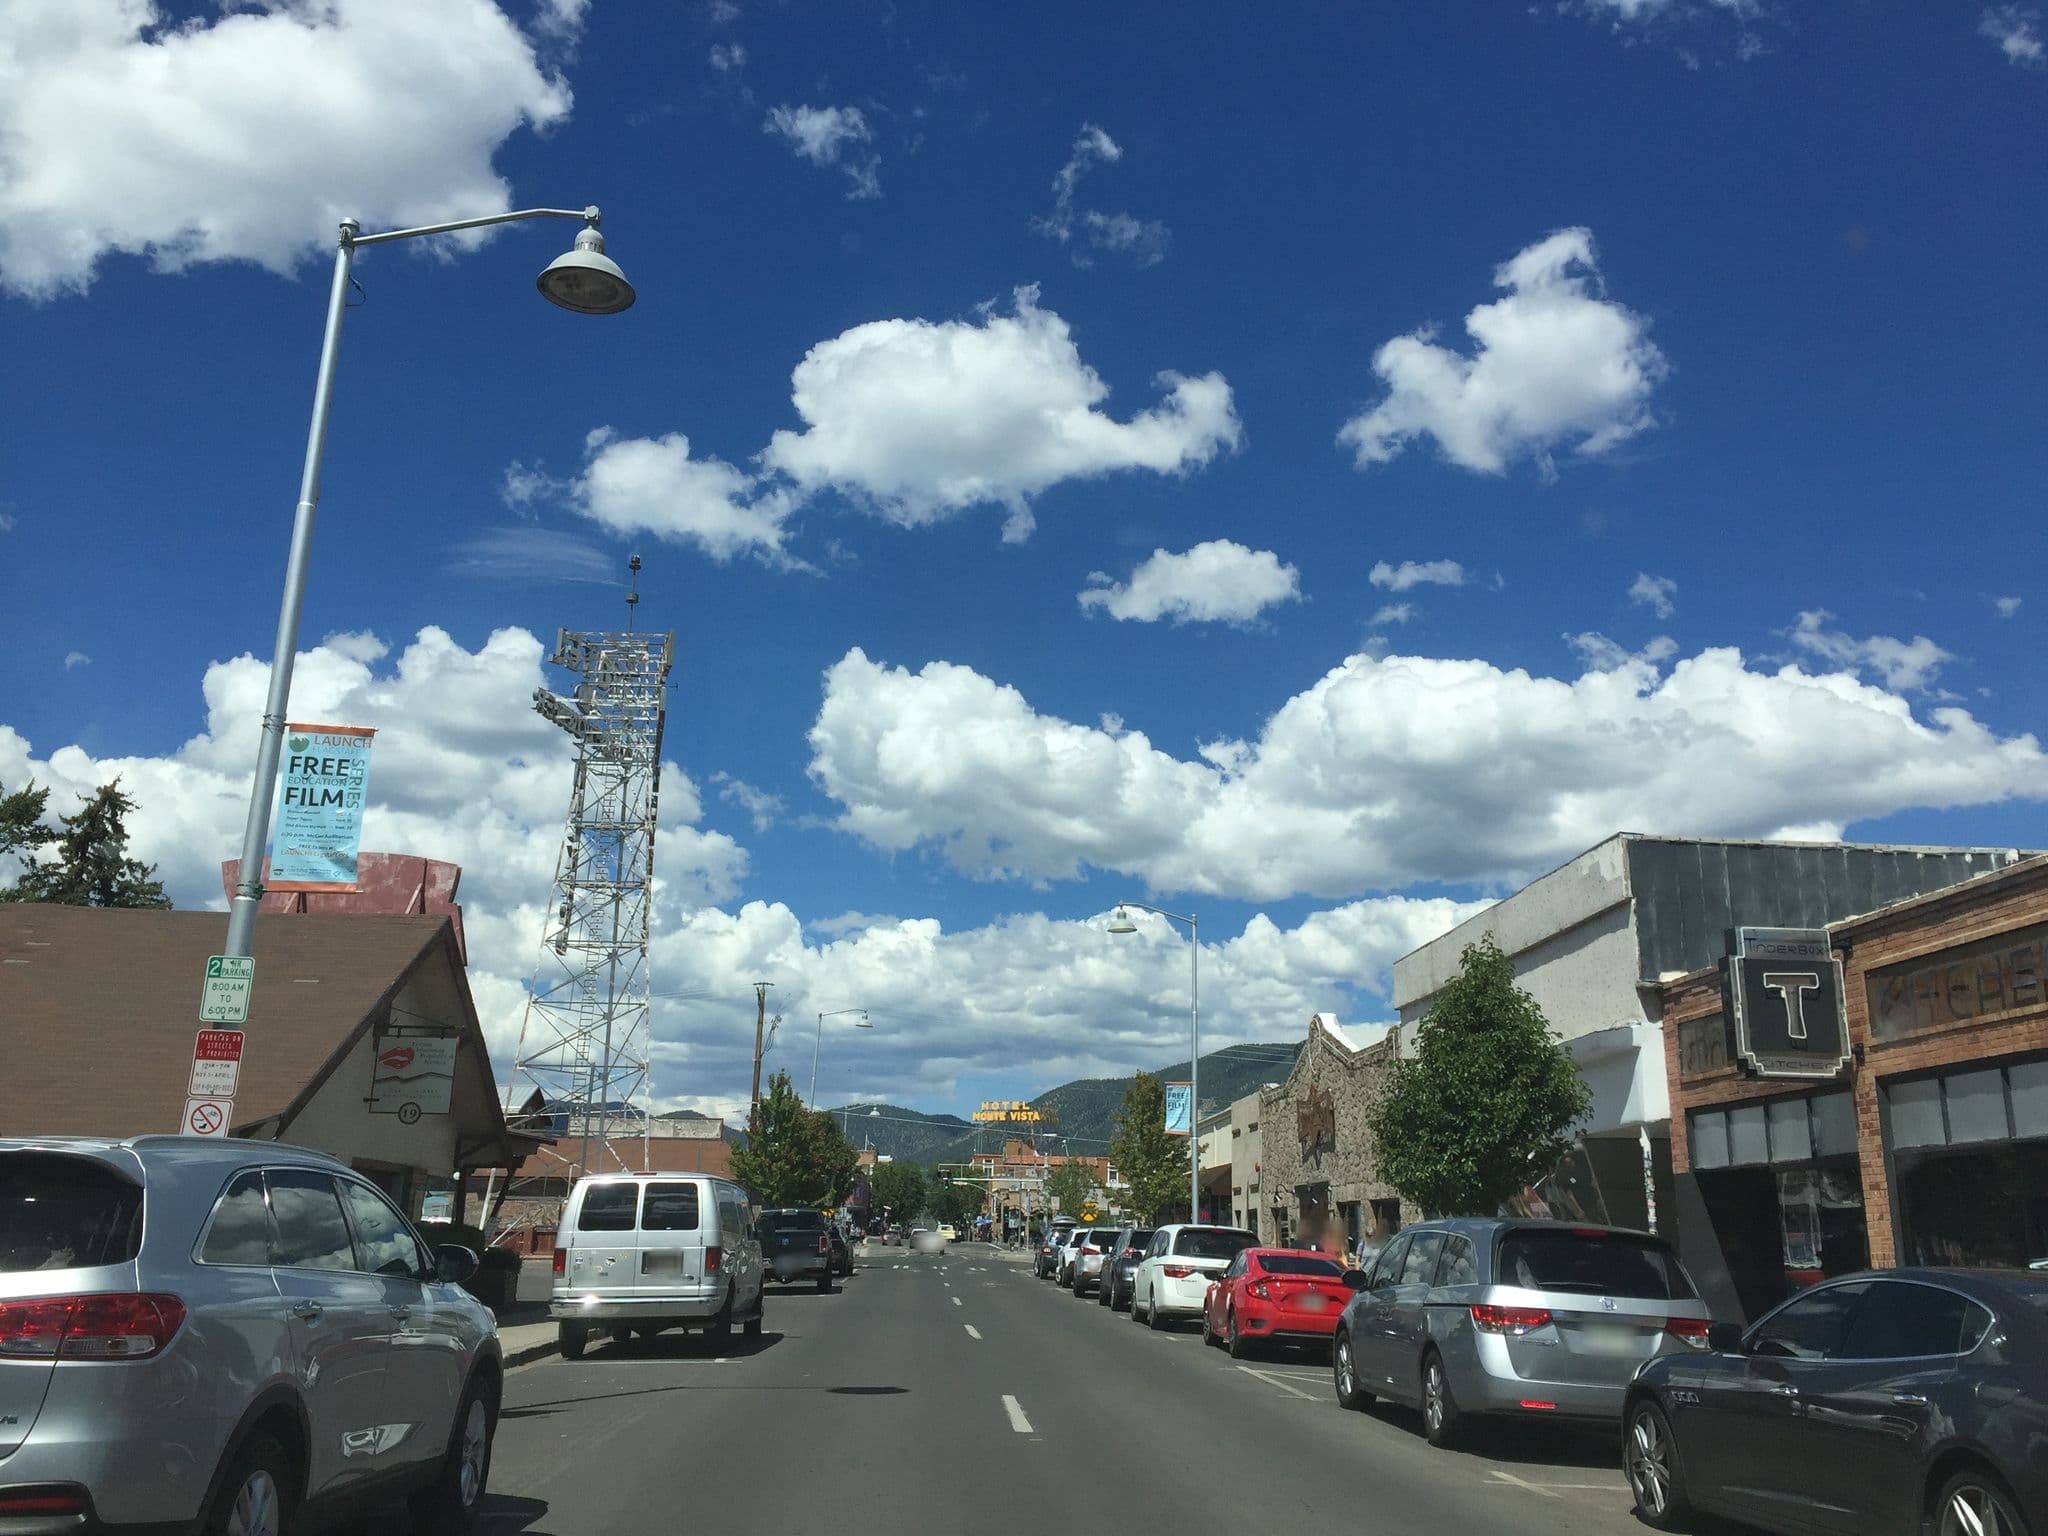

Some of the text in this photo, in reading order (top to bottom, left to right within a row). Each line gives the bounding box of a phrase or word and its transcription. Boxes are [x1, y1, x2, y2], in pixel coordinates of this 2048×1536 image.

[313, 735, 372, 749] LAUNCH
[289, 755, 350, 777] FREE
[287, 775, 348, 787] EDUCATION
[346, 758, 365, 809] SERIES
[285, 786, 344, 808] FILM
[209, 960, 220, 976] 2
[221, 968, 250, 977] PARKING
[211, 982, 244, 991] 8:00 AM
[220, 994, 232, 1003] TO
[208, 1006, 241, 1015] 6:00 PM
[1763, 972, 1820, 1040] T
[981, 1101, 1030, 1110] HOTEL
[403, 1108, 417, 1119] 19
[972, 1111, 1040, 1121] MONTE VISTA
